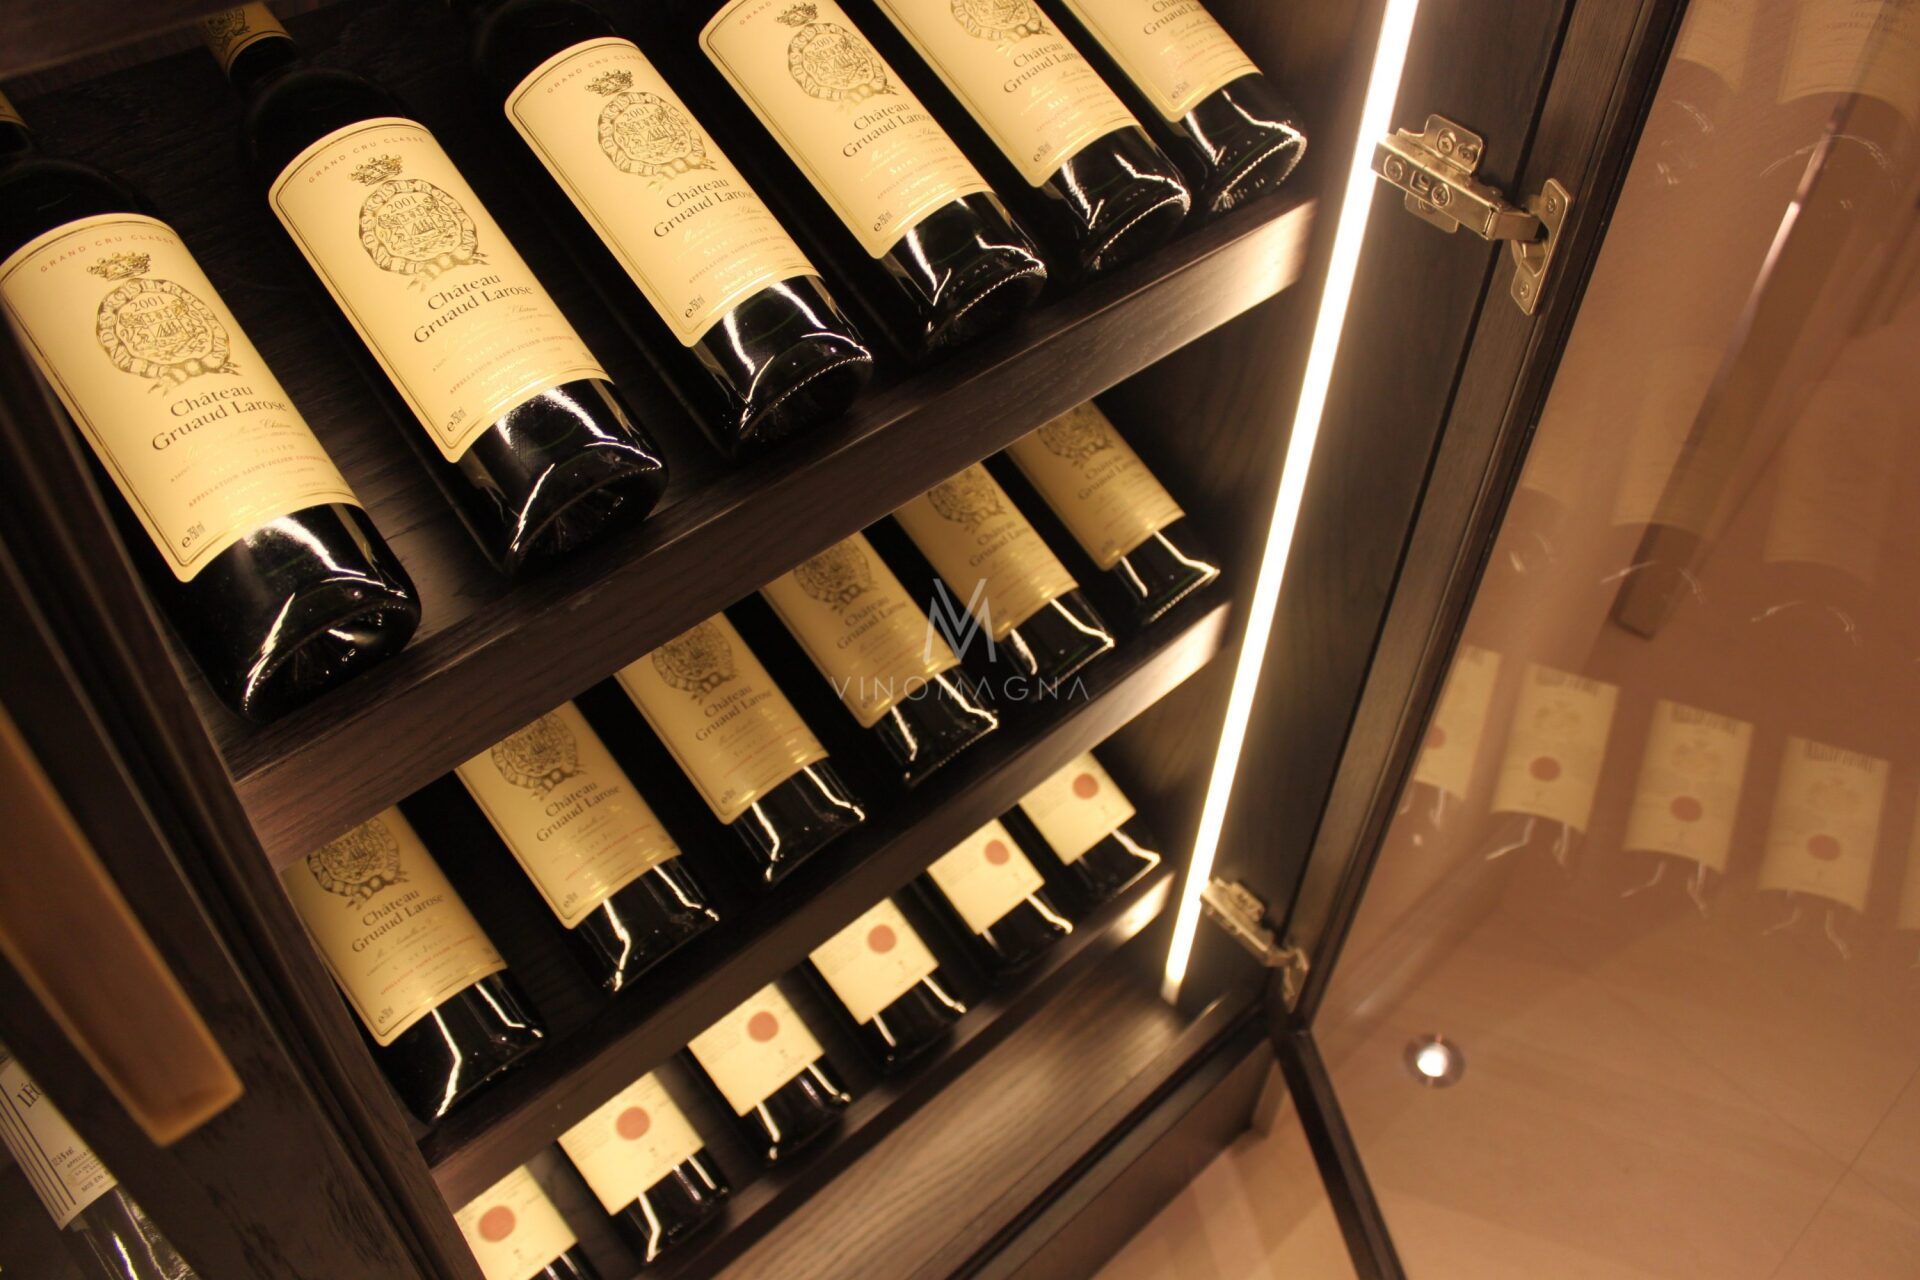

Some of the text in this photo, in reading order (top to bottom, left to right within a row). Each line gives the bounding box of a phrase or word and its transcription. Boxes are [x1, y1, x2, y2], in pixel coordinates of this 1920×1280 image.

[1012, 41, 1064, 68] Château
[546, 67, 584, 94] GRAND
[1003, 55, 1055, 94] Gruaud
[622, 106, 650, 121] 2001
[853, 102, 911, 131] Château
[842, 118, 898, 159] Gruaud
[308, 154, 347, 184] GRAND
[352, 141, 377, 154] CRU
[386, 195, 418, 214] 2001
[665, 175, 730, 210] Château
[652, 198, 715, 239] Gruaud
[40, 246, 87, 273] GRAND
[95, 235, 122, 248] CRU
[129, 295, 166, 313] 2001
[428, 272, 503, 311] Château
[413, 298, 480, 344] Gruaud
[484, 283, 534, 305] Larose
[170, 384, 254, 417] Château
[152, 405, 229, 451] Gruaud
[231, 399, 288, 415] Larose
[544, 781, 598, 818] Château
[536, 803, 586, 843] Gruaud
[351, 893, 444, 954] Gruaud Larose
[362, 889, 421, 928] Château
